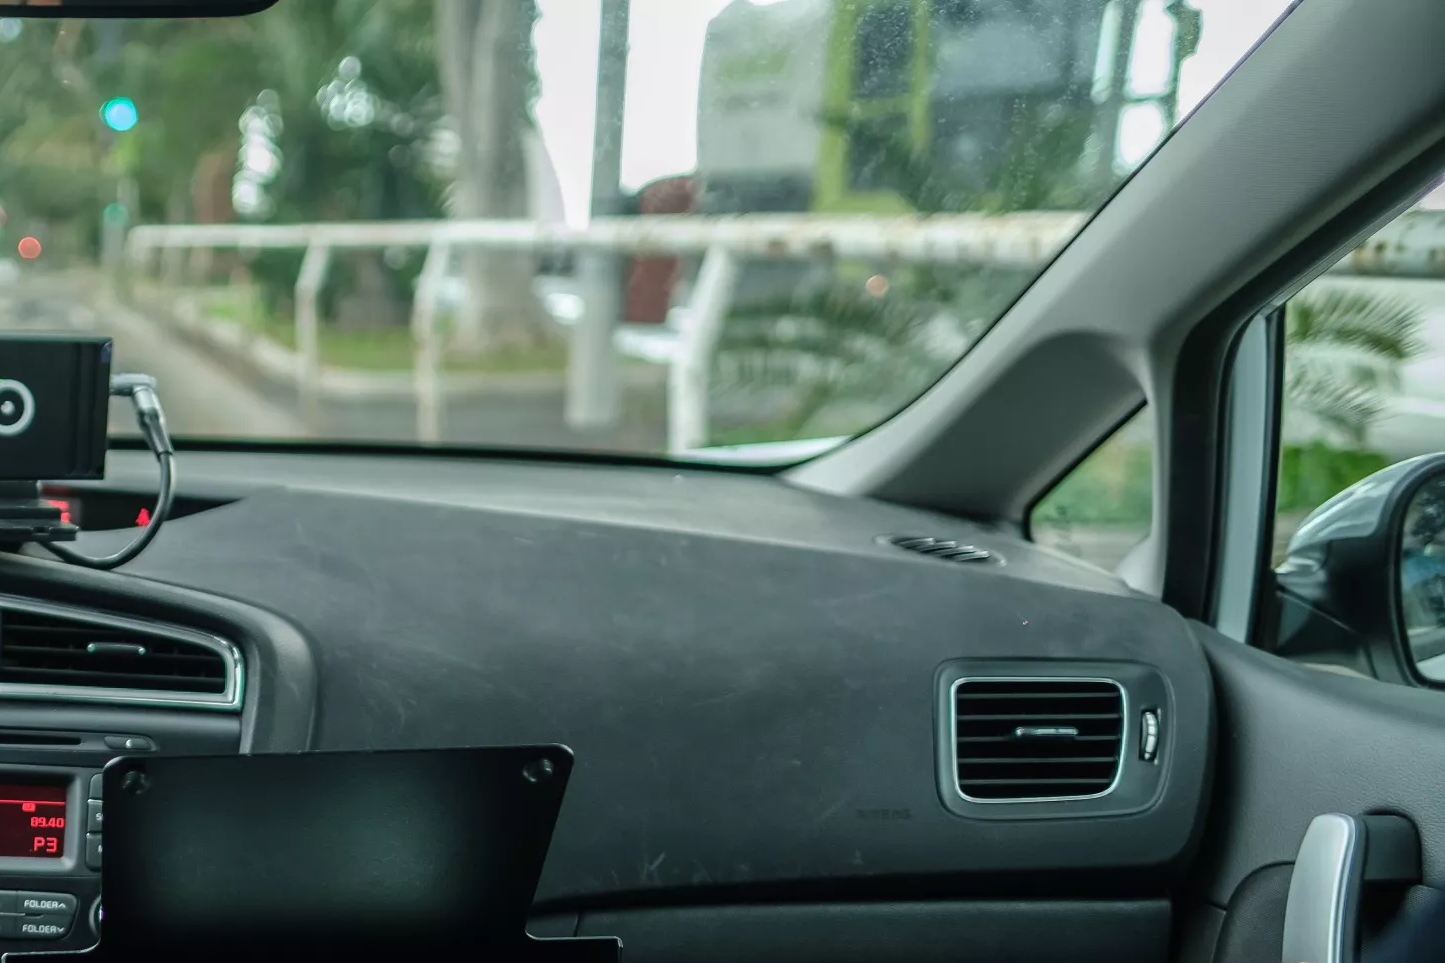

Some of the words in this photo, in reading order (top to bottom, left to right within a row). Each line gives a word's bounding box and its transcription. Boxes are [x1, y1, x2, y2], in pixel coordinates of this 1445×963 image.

[33, 837, 58, 853] P3
[24, 900, 59, 909] FOLDER
[22, 924, 58, 933] FOLDER
